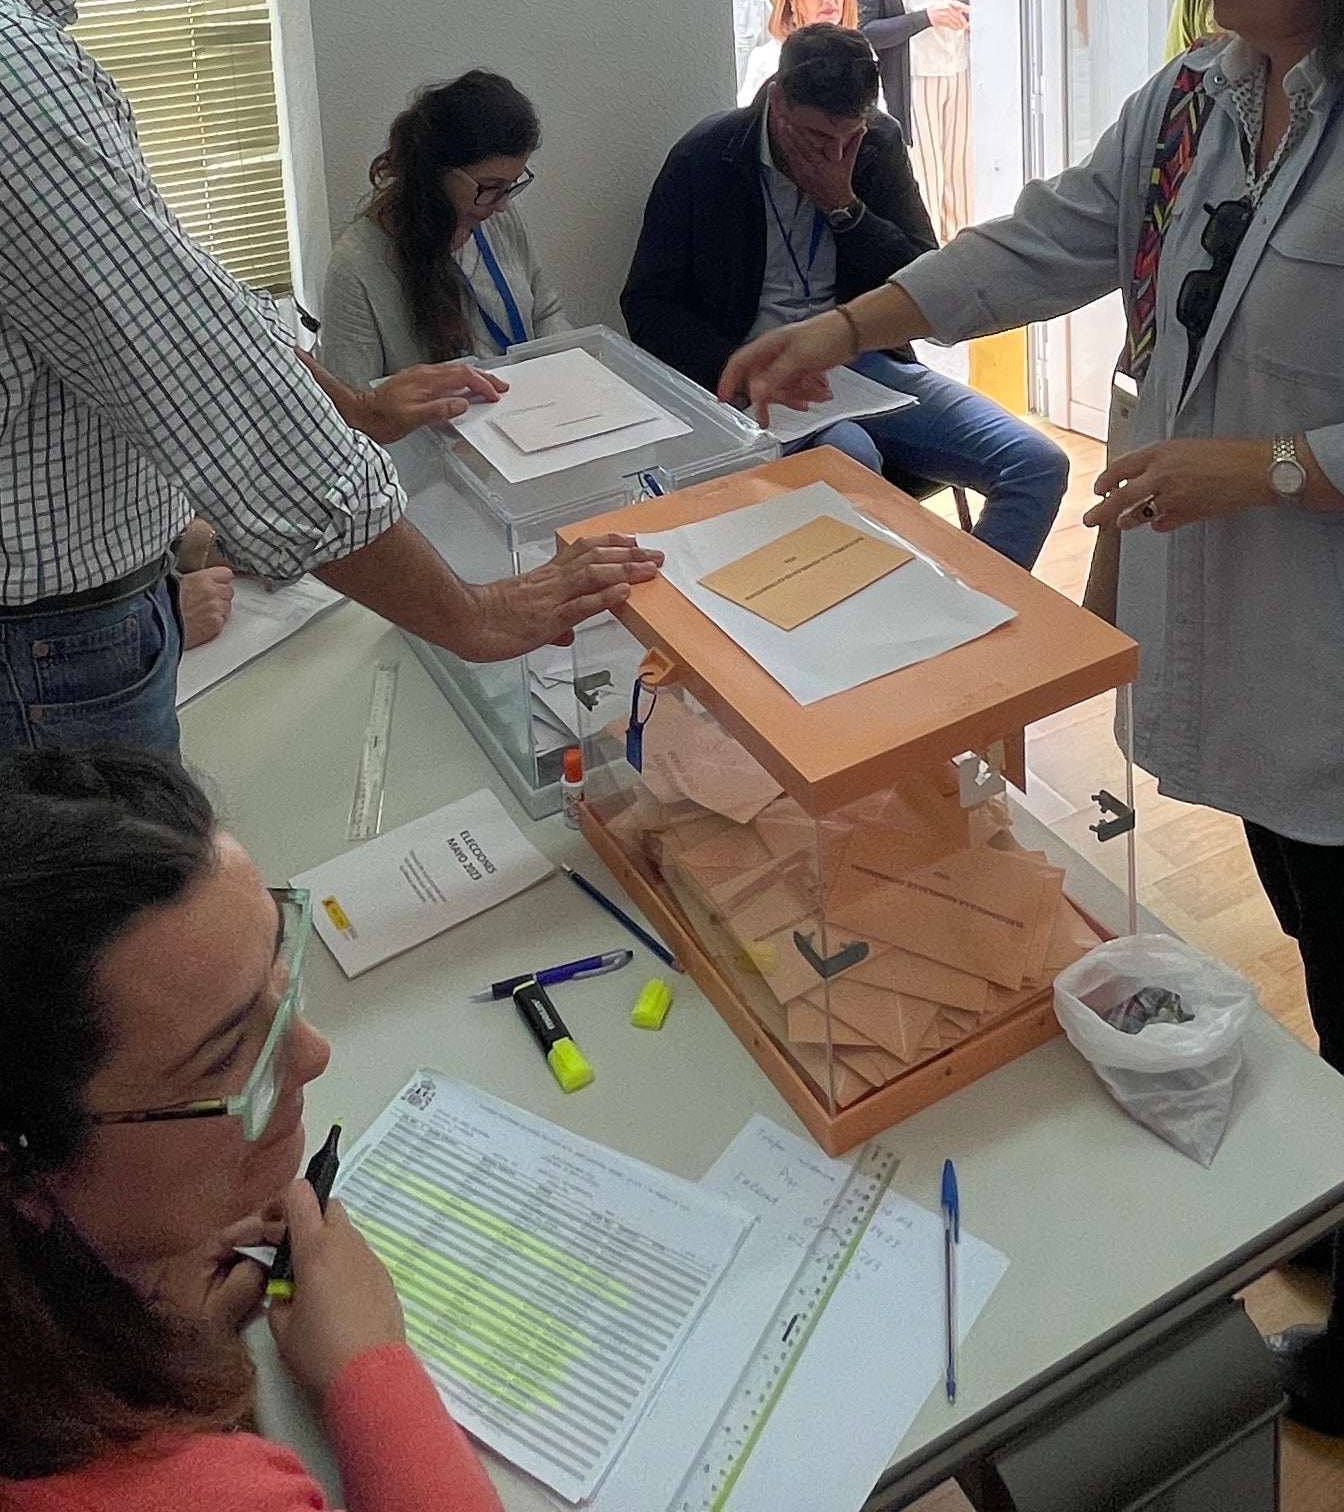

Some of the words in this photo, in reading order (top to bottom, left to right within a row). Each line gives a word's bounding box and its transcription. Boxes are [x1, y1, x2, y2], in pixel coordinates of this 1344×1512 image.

[446, 837, 468, 863] MAYO
[463, 862, 482, 881] 2023
[460, 830, 497, 874] ELECCIONES
